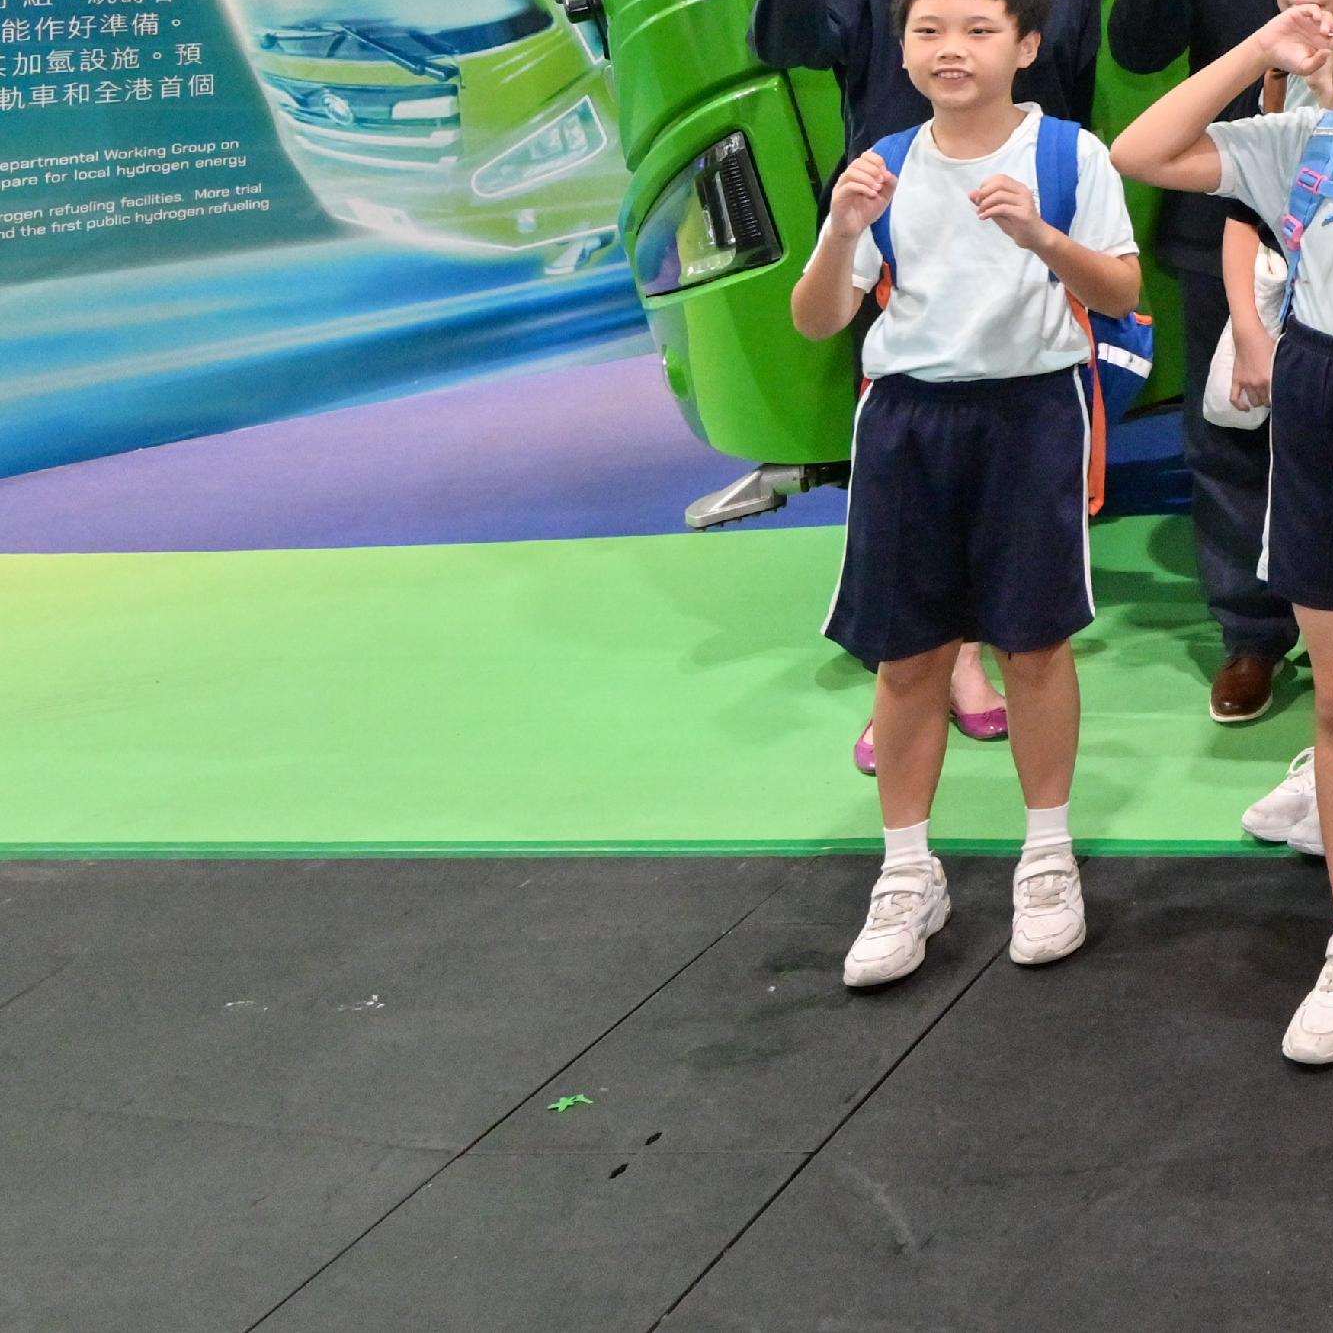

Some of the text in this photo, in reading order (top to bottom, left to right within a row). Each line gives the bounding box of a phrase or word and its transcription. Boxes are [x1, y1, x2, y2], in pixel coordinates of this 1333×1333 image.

[1, 12, 181, 44] 能作好準備。
[104, 145, 166, 161] Working
[172, 141, 216, 155] Group
[221, 140, 239, 150] on
[45, 171, 67, 184] for
[74, 166, 110, 181] local
[116, 159, 189, 178] hydrogen
[195, 154, 247, 170] energy
[49, 199, 115, 217] refueling
[195, 188, 230, 200] More
[235, 183, 263, 196] trial
[20, 224, 46, 237] the
[51, 220, 82, 233] first
[86, 215, 131, 230] public
[135, 206, 205, 225] hydrogen
[208, 198, 270, 216] refueling
